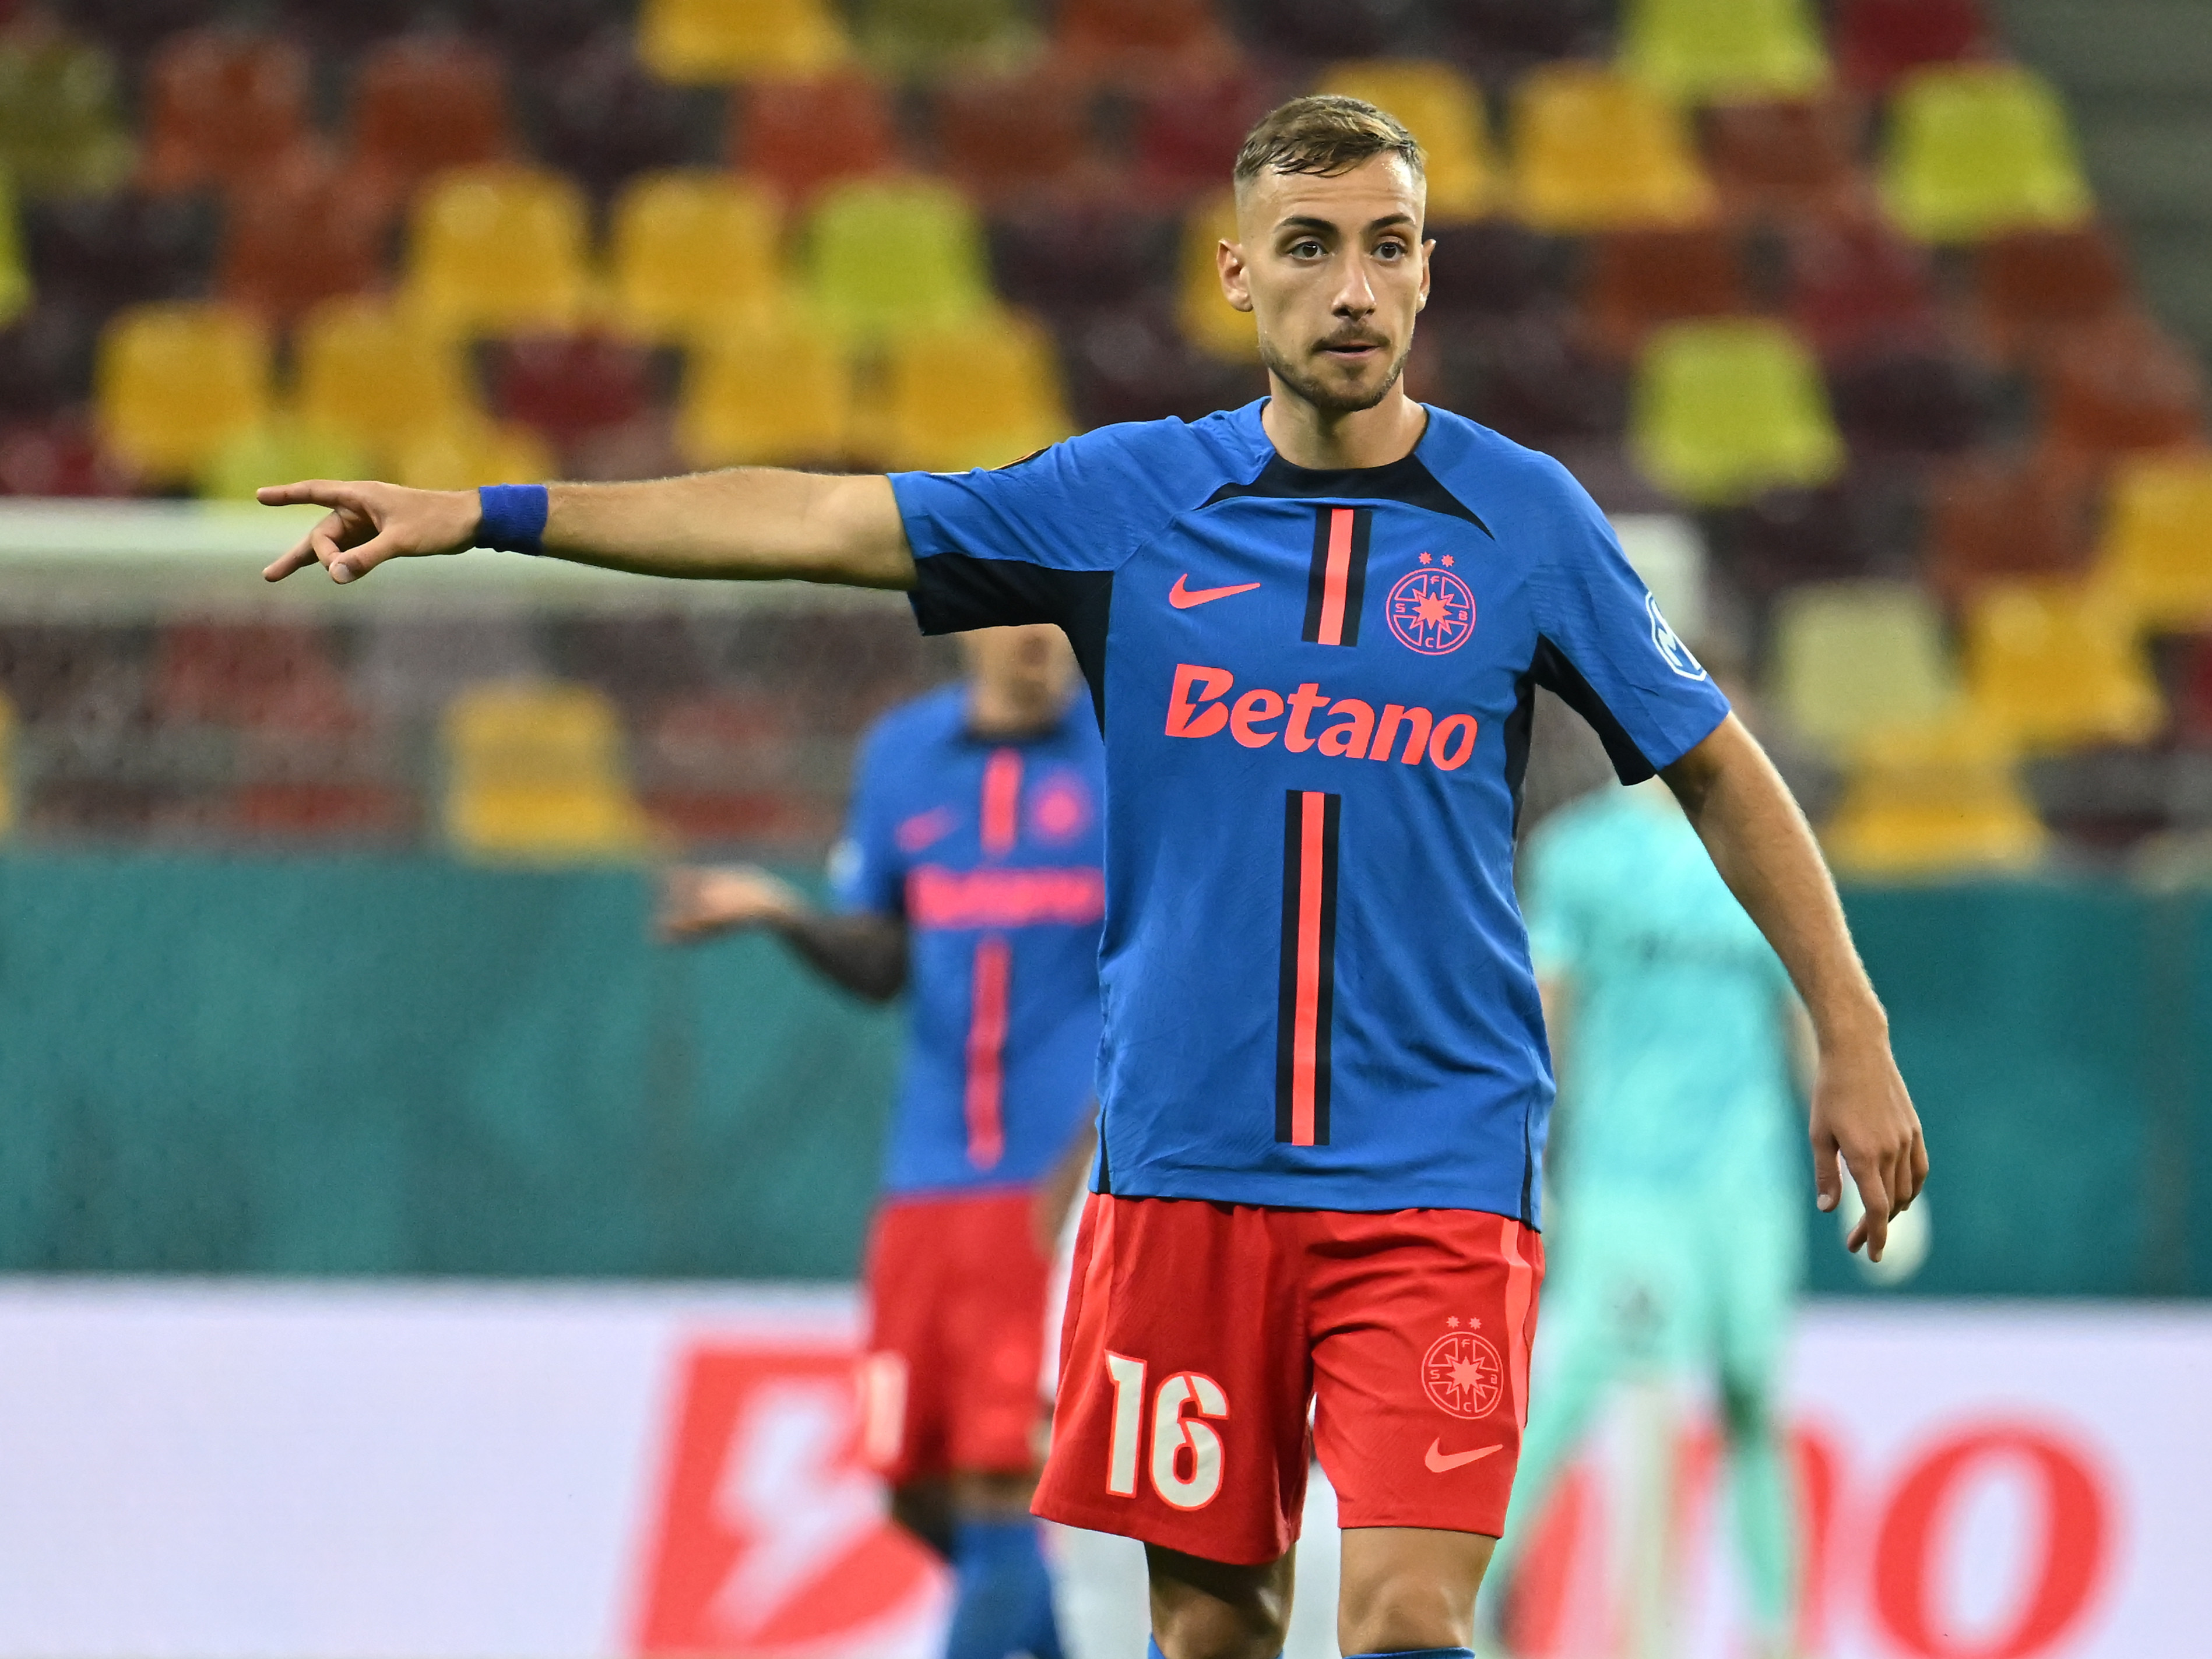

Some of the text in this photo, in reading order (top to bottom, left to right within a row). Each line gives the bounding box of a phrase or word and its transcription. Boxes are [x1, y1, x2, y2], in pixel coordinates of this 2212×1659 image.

[1430, 575, 1440, 584] F
[1395, 603, 1406, 613] S
[1425, 637, 1434, 648] C
[1165, 663, 1478, 770] Betano
[1461, 1339, 1471, 1348] F
[1429, 1369, 1440, 1379] S
[1463, 1401, 1472, 1413] C
[1105, 1350, 1230, 1511] 16
